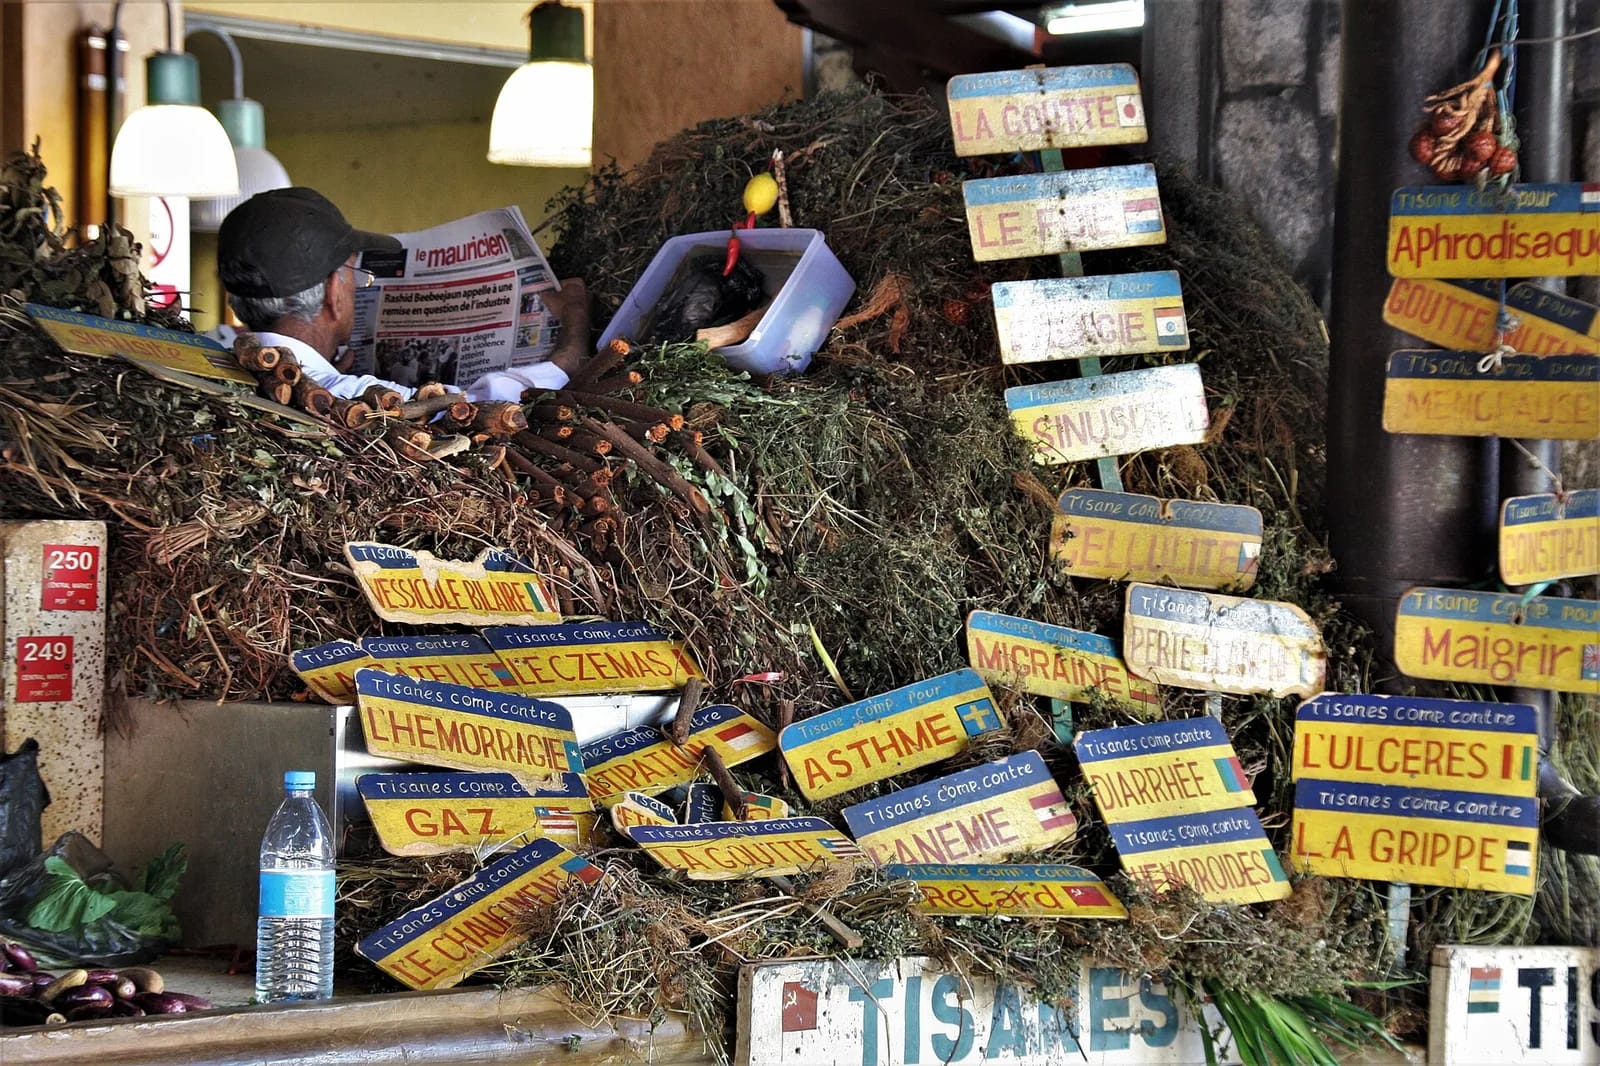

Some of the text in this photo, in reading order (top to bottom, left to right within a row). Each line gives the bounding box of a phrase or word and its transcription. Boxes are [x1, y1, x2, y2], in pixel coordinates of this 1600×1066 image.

[955, 95, 1118, 142] LA GOUTTE
[1399, 192, 1461, 209] Tisane
[1517, 190, 1559, 209] pour
[976, 211, 1024, 248] LE
[1392, 219, 1600, 268] Aphrodisaqu
[415, 248, 427, 263] le
[427, 232, 510, 268] mauricien
[382, 306, 411, 317] remise
[412, 306, 422, 316] en
[423, 302, 459, 318] question
[460, 301, 470, 312] de
[384, 293, 413, 304] Rashid
[462, 284, 491, 299] appelle
[498, 283, 513, 293] une
[1386, 277, 1493, 345] GOUTTE
[472, 339, 506, 350] violence
[1068, 494, 1122, 515] Tisane
[49, 550, 93, 571] 250
[371, 577, 534, 613] VESSICULE BILAIRE
[1412, 592, 1480, 614] Tisane
[23, 641, 68, 663] 249
[367, 642, 413, 653] comp.
[416, 639, 470, 650] contre
[505, 630, 567, 645] Tisanes
[1130, 625, 1193, 672] PERTE
[1422, 625, 1574, 682] Maigrir
[975, 637, 1122, 695] MIGRAINE
[372, 677, 557, 722] Tisanes comp. contre
[1311, 699, 1389, 719] Tisanes
[1450, 708, 1517, 727] contre
[366, 706, 570, 772] L'HEMORRAGIE
[798, 717, 845, 739] Tisane
[1085, 727, 1213, 758] Tisanes comp. contre
[803, 713, 958, 790] ASTHME
[1302, 731, 1489, 780] L'ULCERES
[376, 780, 452, 795] Tisanes
[458, 780, 507, 797] comp.
[864, 762, 1034, 826] Tisanes comp. contre
[1090, 757, 1212, 811] DIARRHÉE
[1318, 789, 1392, 810] Tisanes
[1454, 797, 1524, 819] contre
[404, 807, 506, 837] GAZ
[643, 826, 713, 840] Tisanes
[764, 818, 813, 832] contre
[868, 806, 1019, 866] L'ANEMIE
[1125, 817, 1251, 848] Tisanes comp. contre
[654, 838, 818, 871] LA GOUTTE
[1369, 828, 1500, 874] GRIPPE
[909, 865, 970, 878] Tisane
[373, 847, 542, 952] Tisanes comp. contre
[919, 882, 1065, 911] Retard
[847, 964, 1181, 1066] TISANES
[1517, 966, 1600, 1051] TI
